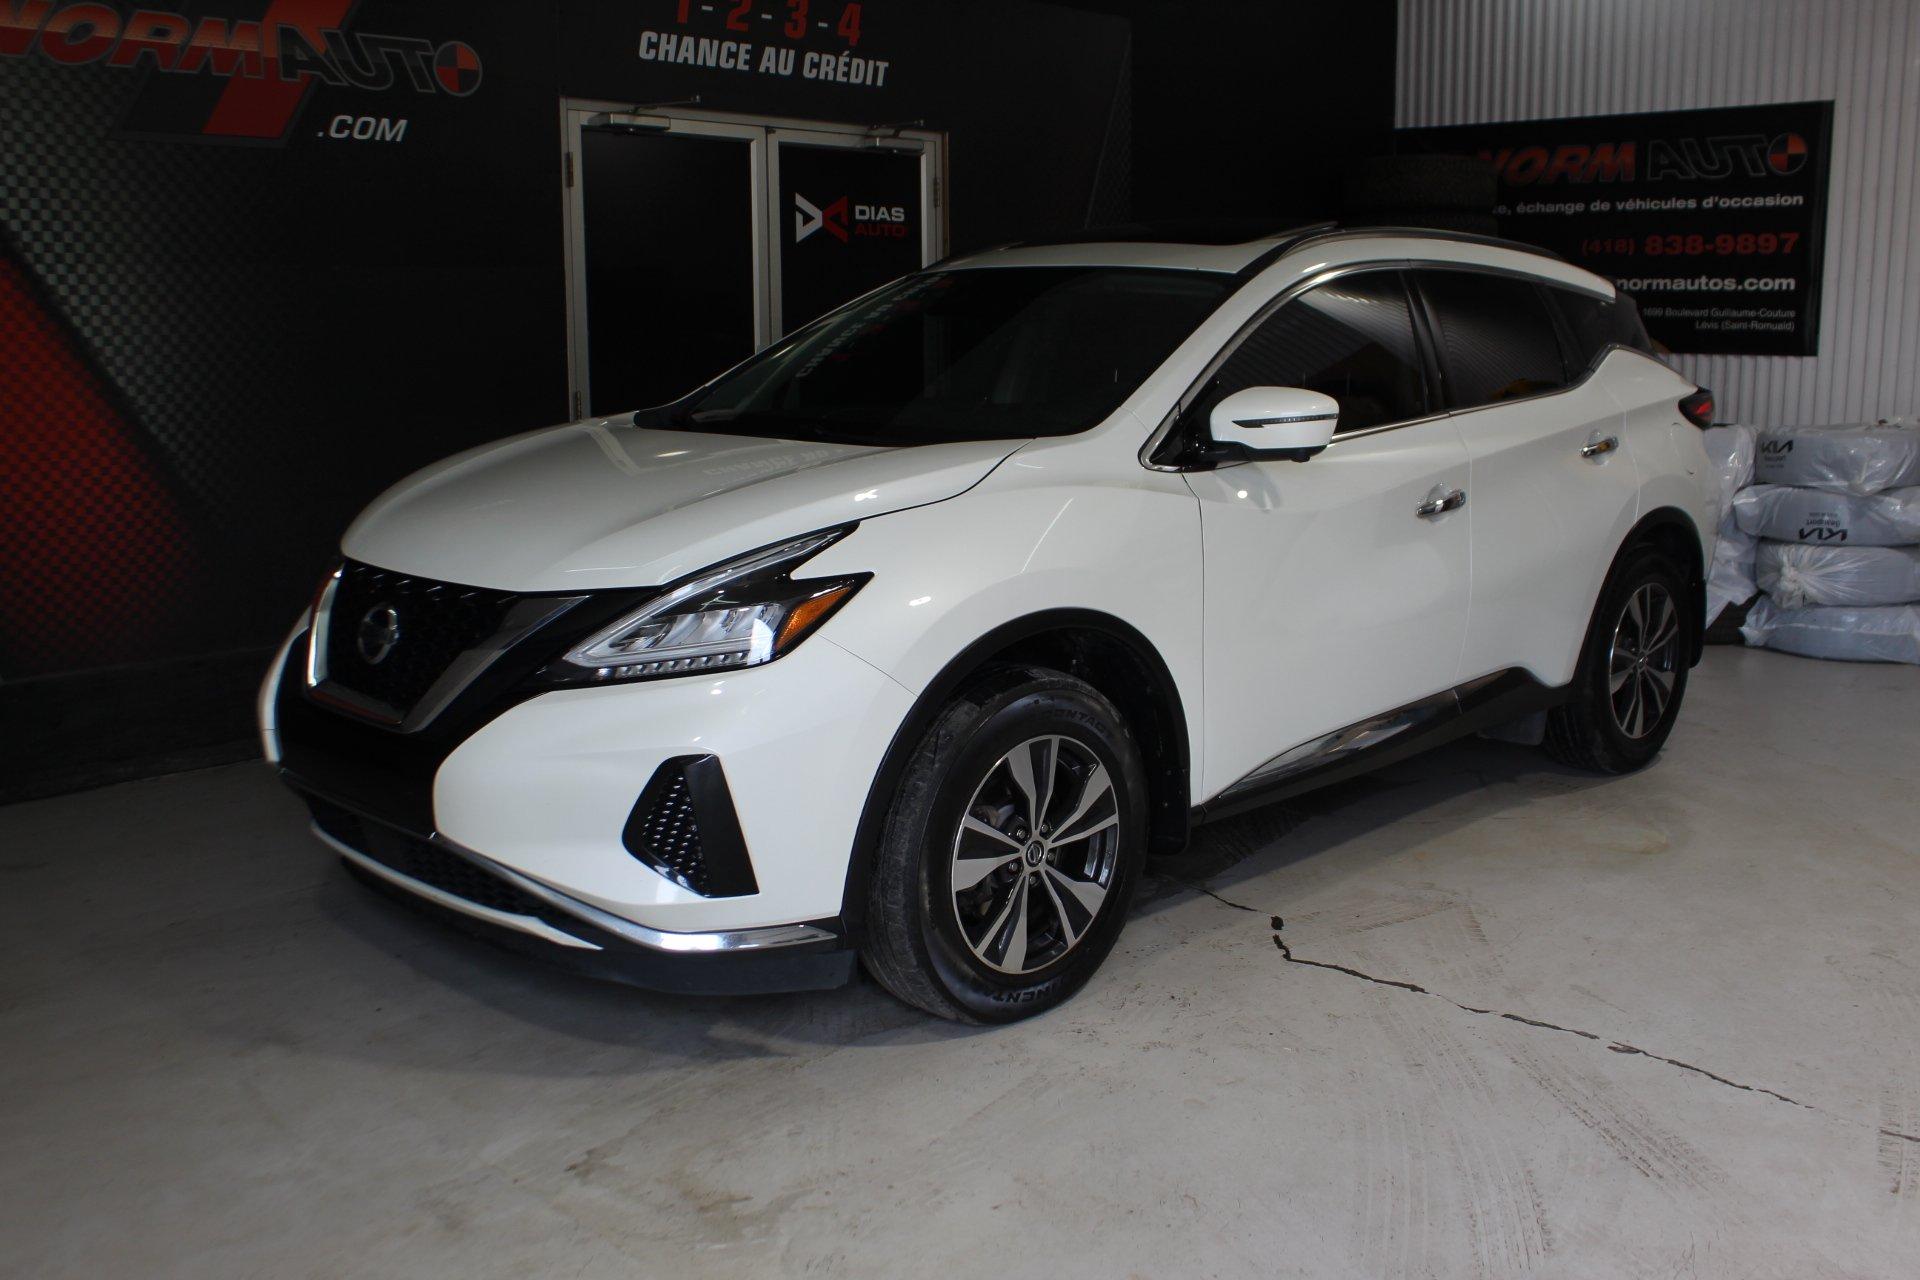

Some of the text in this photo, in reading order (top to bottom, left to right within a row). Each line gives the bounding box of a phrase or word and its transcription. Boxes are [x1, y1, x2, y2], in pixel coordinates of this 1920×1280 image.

[638, 30, 890, 87] CHANCE AU CRÉDIT
[315, 112, 408, 143] .COM
[854, 204, 905, 222] DIAS
[1516, 200, 1585, 217] échange
[1590, 199, 1611, 212] de
[1616, 196, 1697, 211] véhicules
[1702, 193, 1804, 209] d'occasion
[854, 223, 908, 239] AUTO
[1581, 231, 1801, 256] (418) 838-9897
[1665, 306, 1709, 318] Boulevard
[1711, 307, 1796, 318] Guillaume-Couture
[1695, 320, 1719, 330] Lévis
[1761, 439, 1793, 453] KIA
[1799, 527, 1848, 542] KIA
